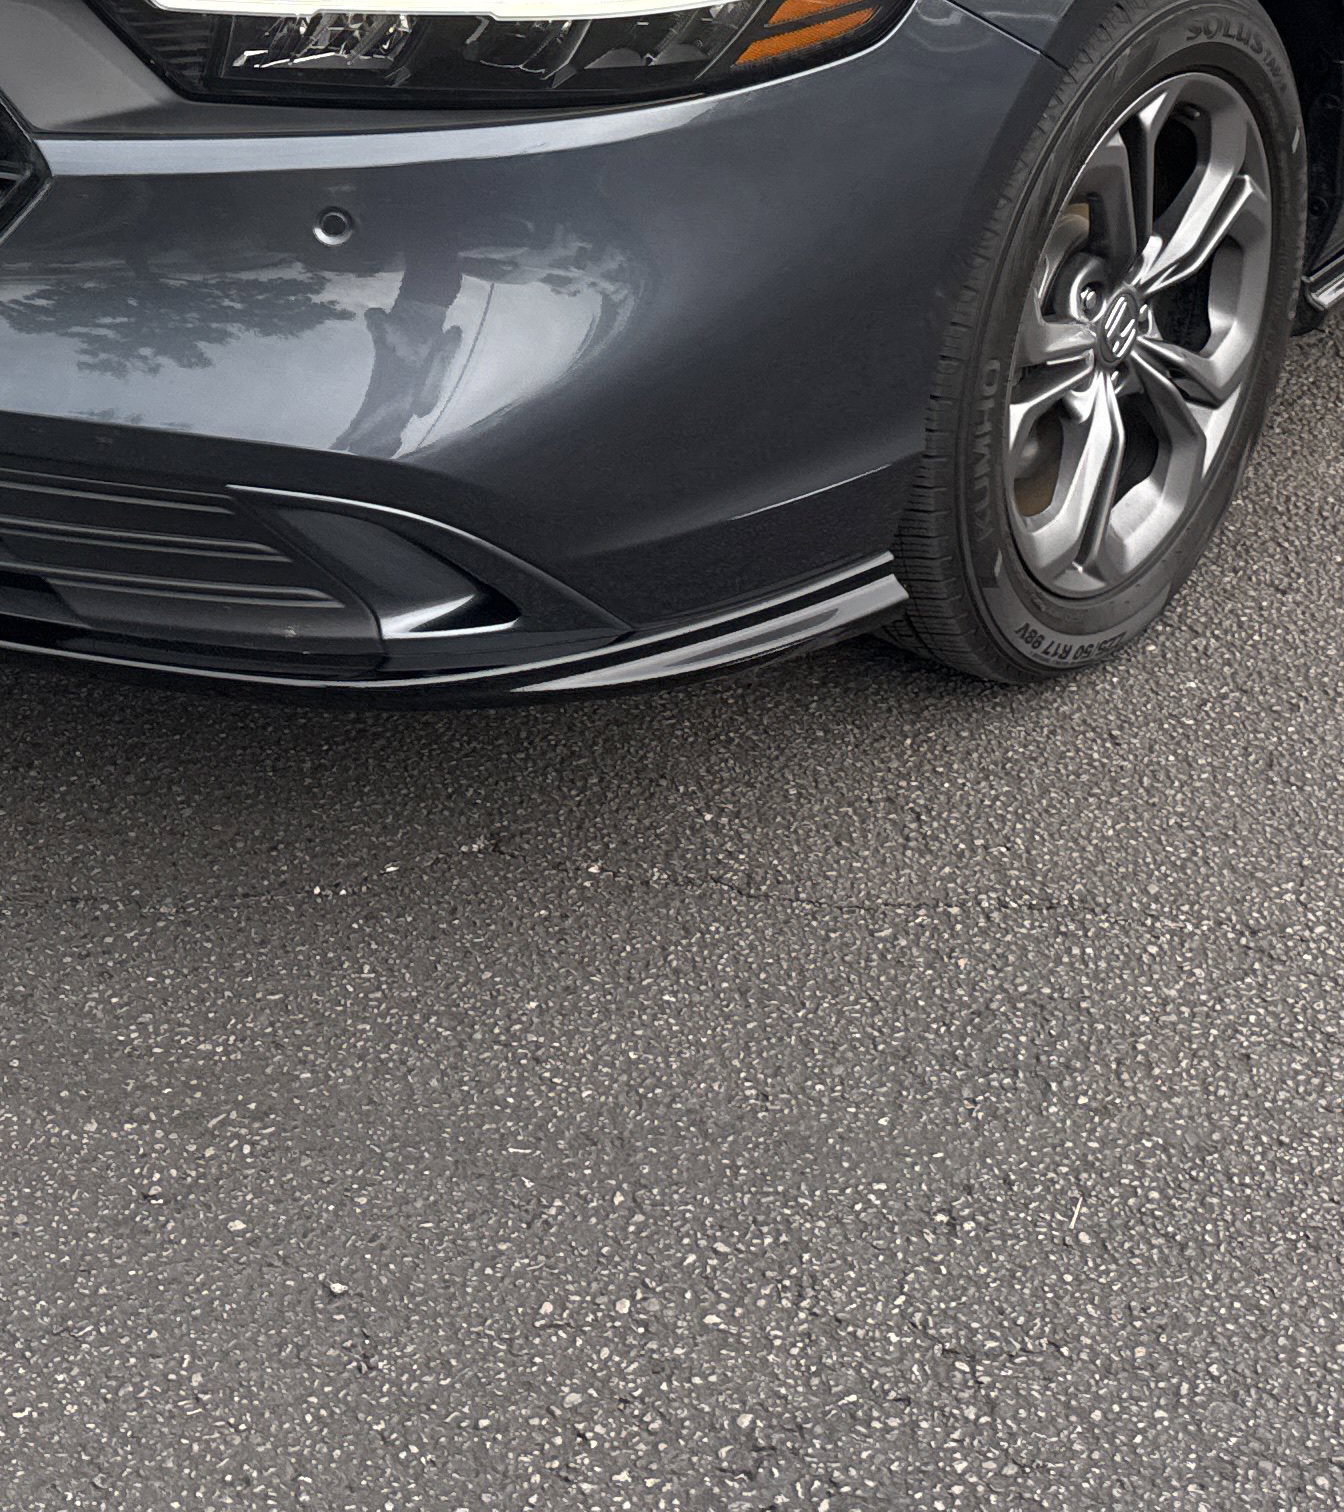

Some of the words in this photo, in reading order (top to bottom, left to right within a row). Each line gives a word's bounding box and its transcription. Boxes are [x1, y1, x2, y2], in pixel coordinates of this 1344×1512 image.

[1186, 16, 1265, 55] SOLUS
[972, 358, 1001, 542] KUMHO
[1014, 622, 1046, 650] 98V
[1042, 640, 1073, 660] R17
